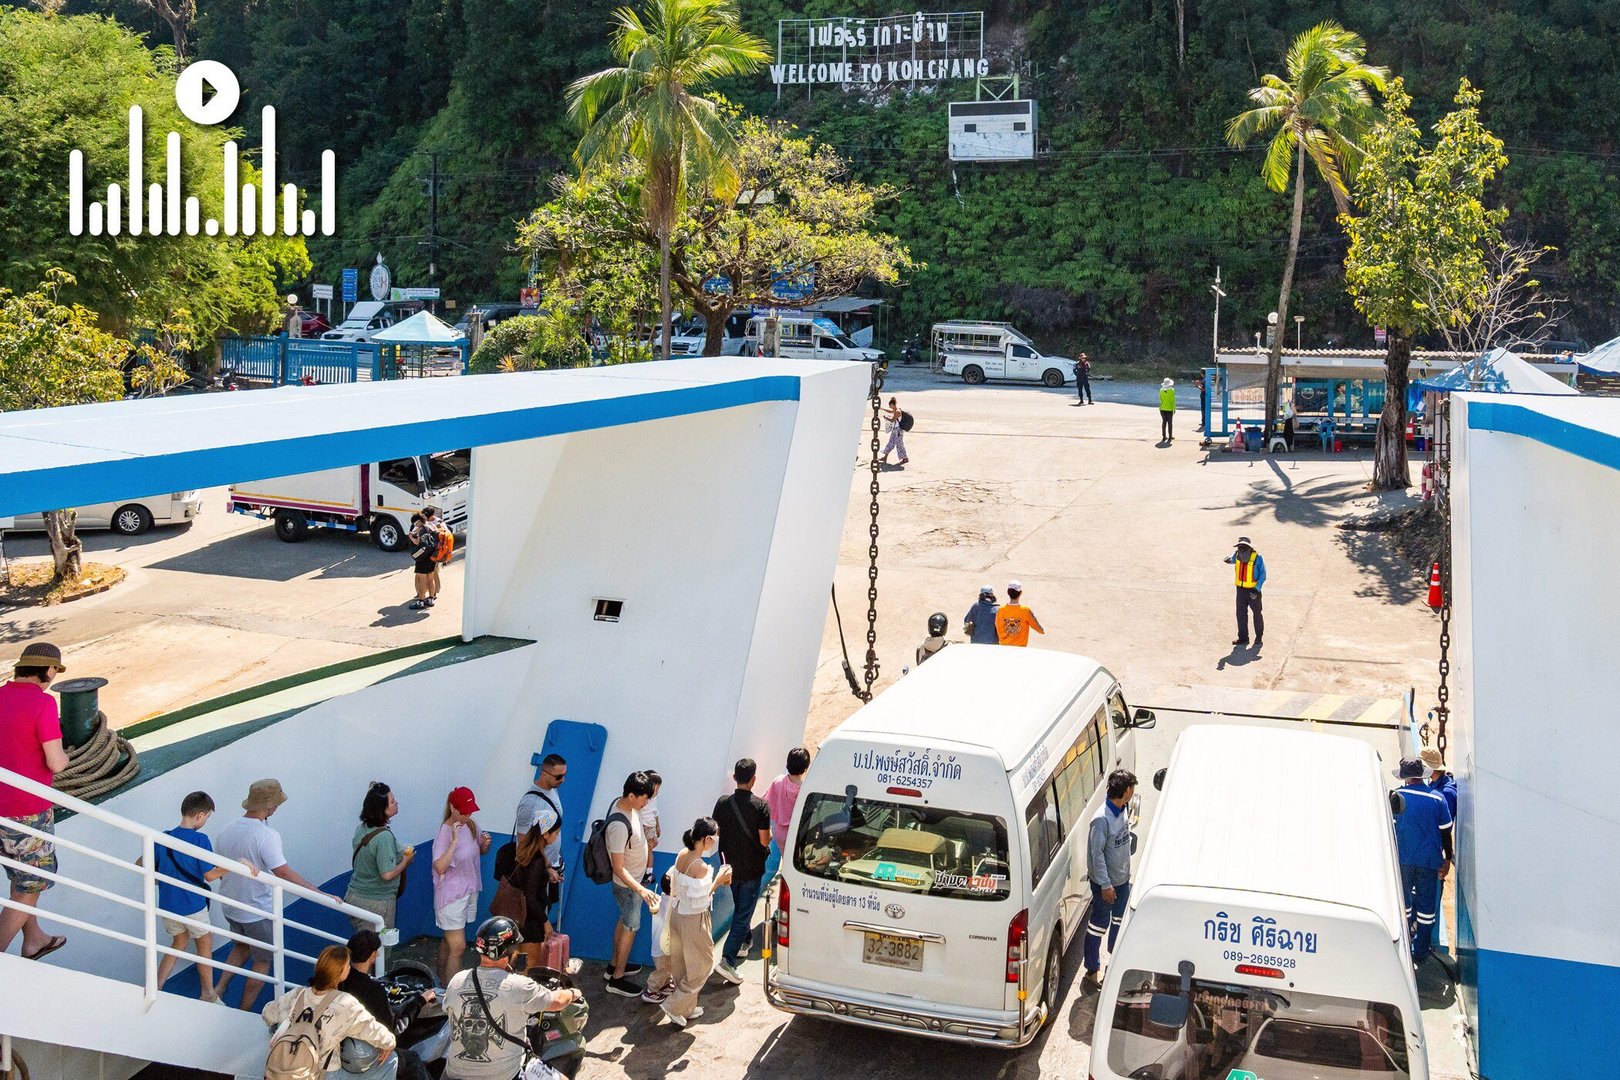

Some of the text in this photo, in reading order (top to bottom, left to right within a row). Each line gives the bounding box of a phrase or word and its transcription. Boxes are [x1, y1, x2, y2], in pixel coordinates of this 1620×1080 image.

[770, 58, 989, 84] WELCOME TO KOH CHANG
[877, 773, 933, 788] 081-6254357
[871, 862, 920, 881] AR Group
[859, 896, 867, 908] 13
[1204, 911, 1317, 953] กริช ศิริฉาย
[867, 938, 920, 960] 32-3882
[1223, 950, 1296, 968] 089-2695928
